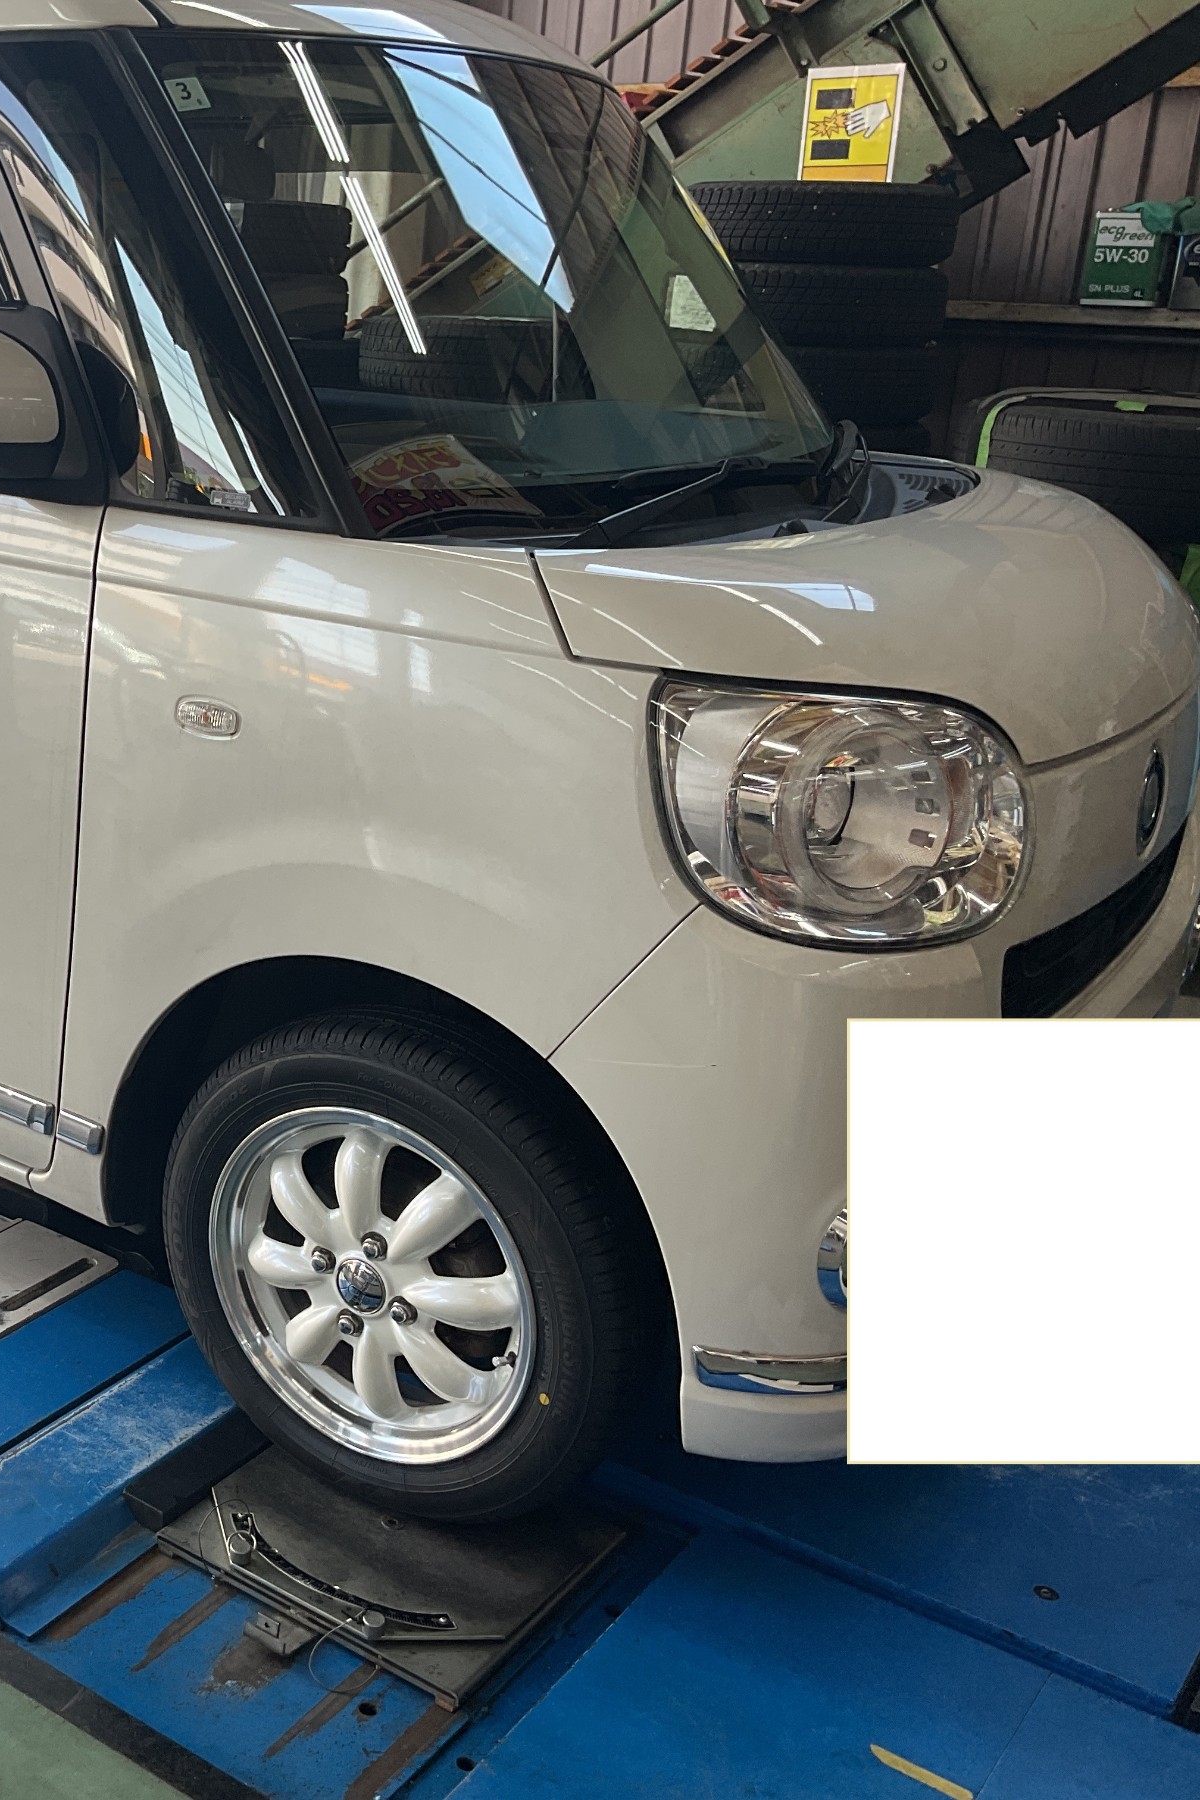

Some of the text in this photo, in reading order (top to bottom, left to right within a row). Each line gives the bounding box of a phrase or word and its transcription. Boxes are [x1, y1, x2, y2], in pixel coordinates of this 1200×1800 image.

[175, 82, 192, 100] 3
[1113, 231, 1153, 242] green
[1094, 248, 1149, 263] 5W-30
[1104, 284, 1130, 293] PLUS
[377, 1078, 430, 1106] COMPACT
